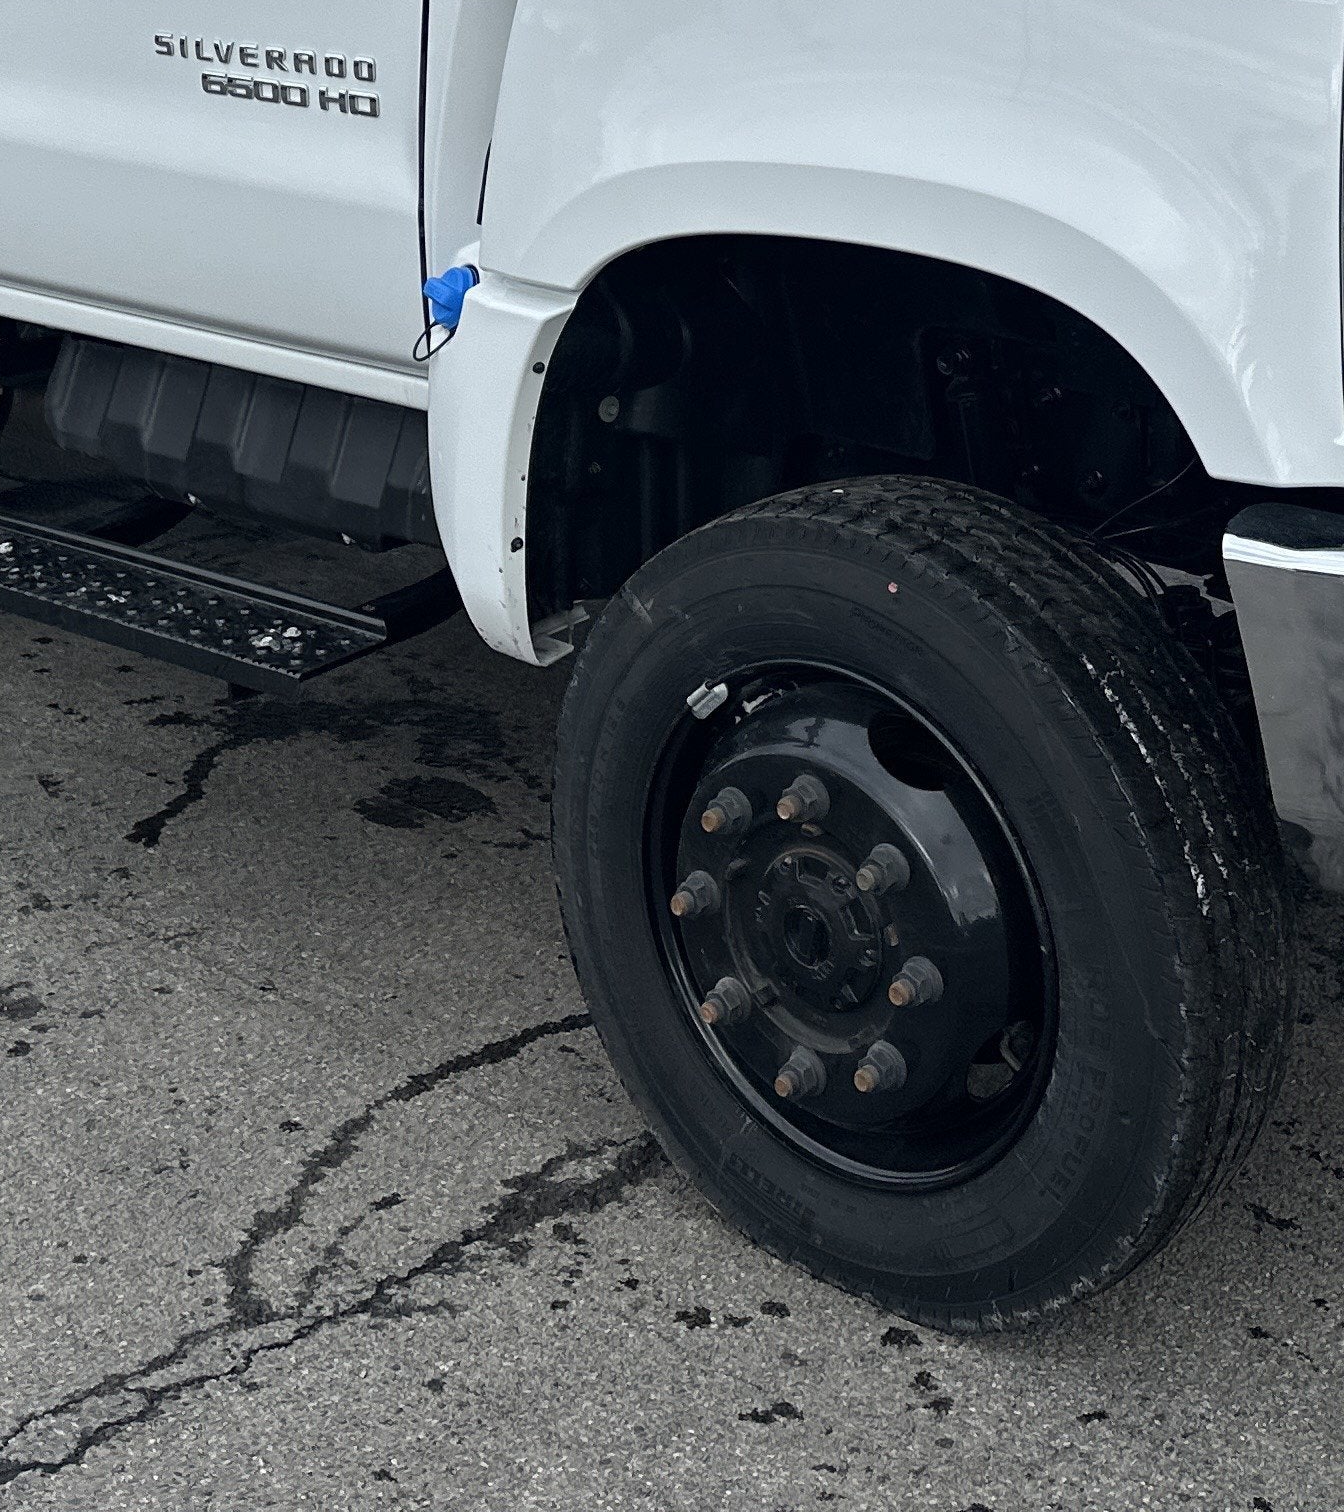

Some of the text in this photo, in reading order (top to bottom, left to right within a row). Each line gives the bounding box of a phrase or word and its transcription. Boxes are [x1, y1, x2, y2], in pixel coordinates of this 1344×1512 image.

[154, 31, 377, 83] SILVERADO
[201, 70, 380, 118] 6500 HD
